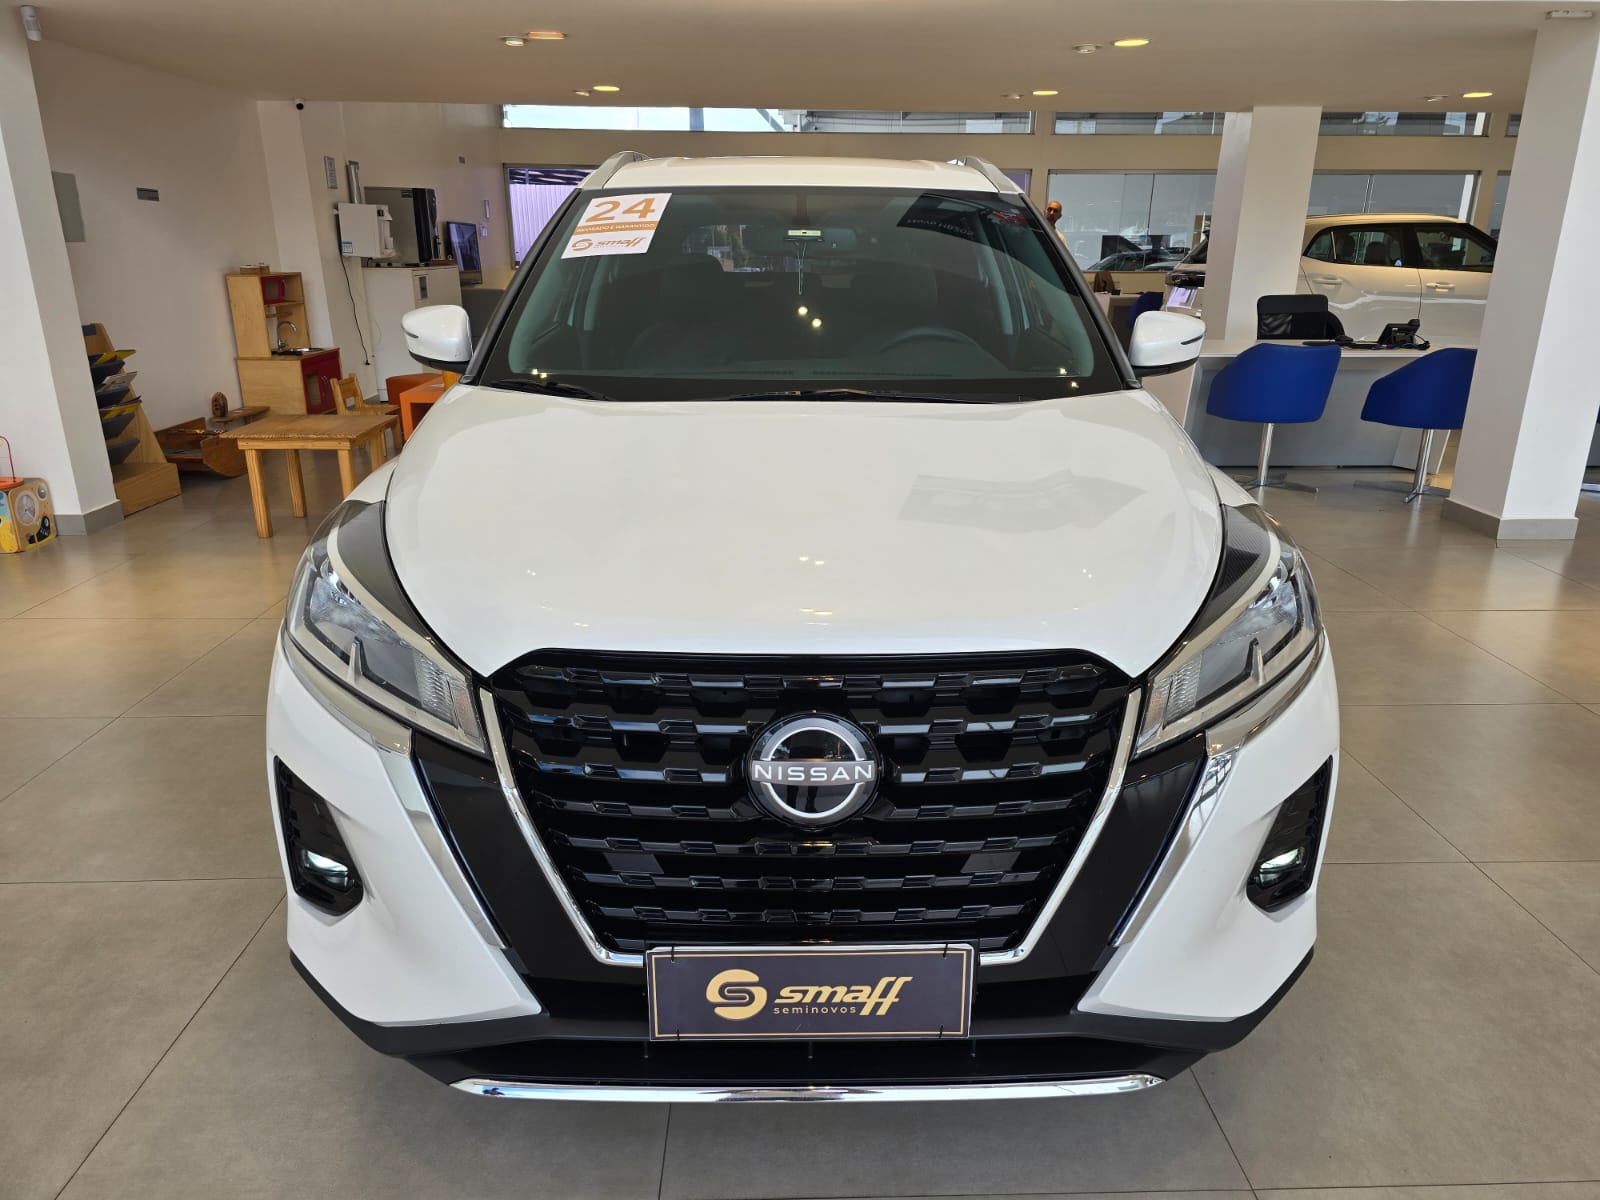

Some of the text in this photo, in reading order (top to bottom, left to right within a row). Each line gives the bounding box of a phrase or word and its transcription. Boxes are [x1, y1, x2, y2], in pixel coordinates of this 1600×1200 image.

[586, 197, 656, 222] 24
[754, 764, 872, 781] NISSAN
[774, 976, 913, 1016] smaff
[773, 1005, 857, 1014] seminovos
